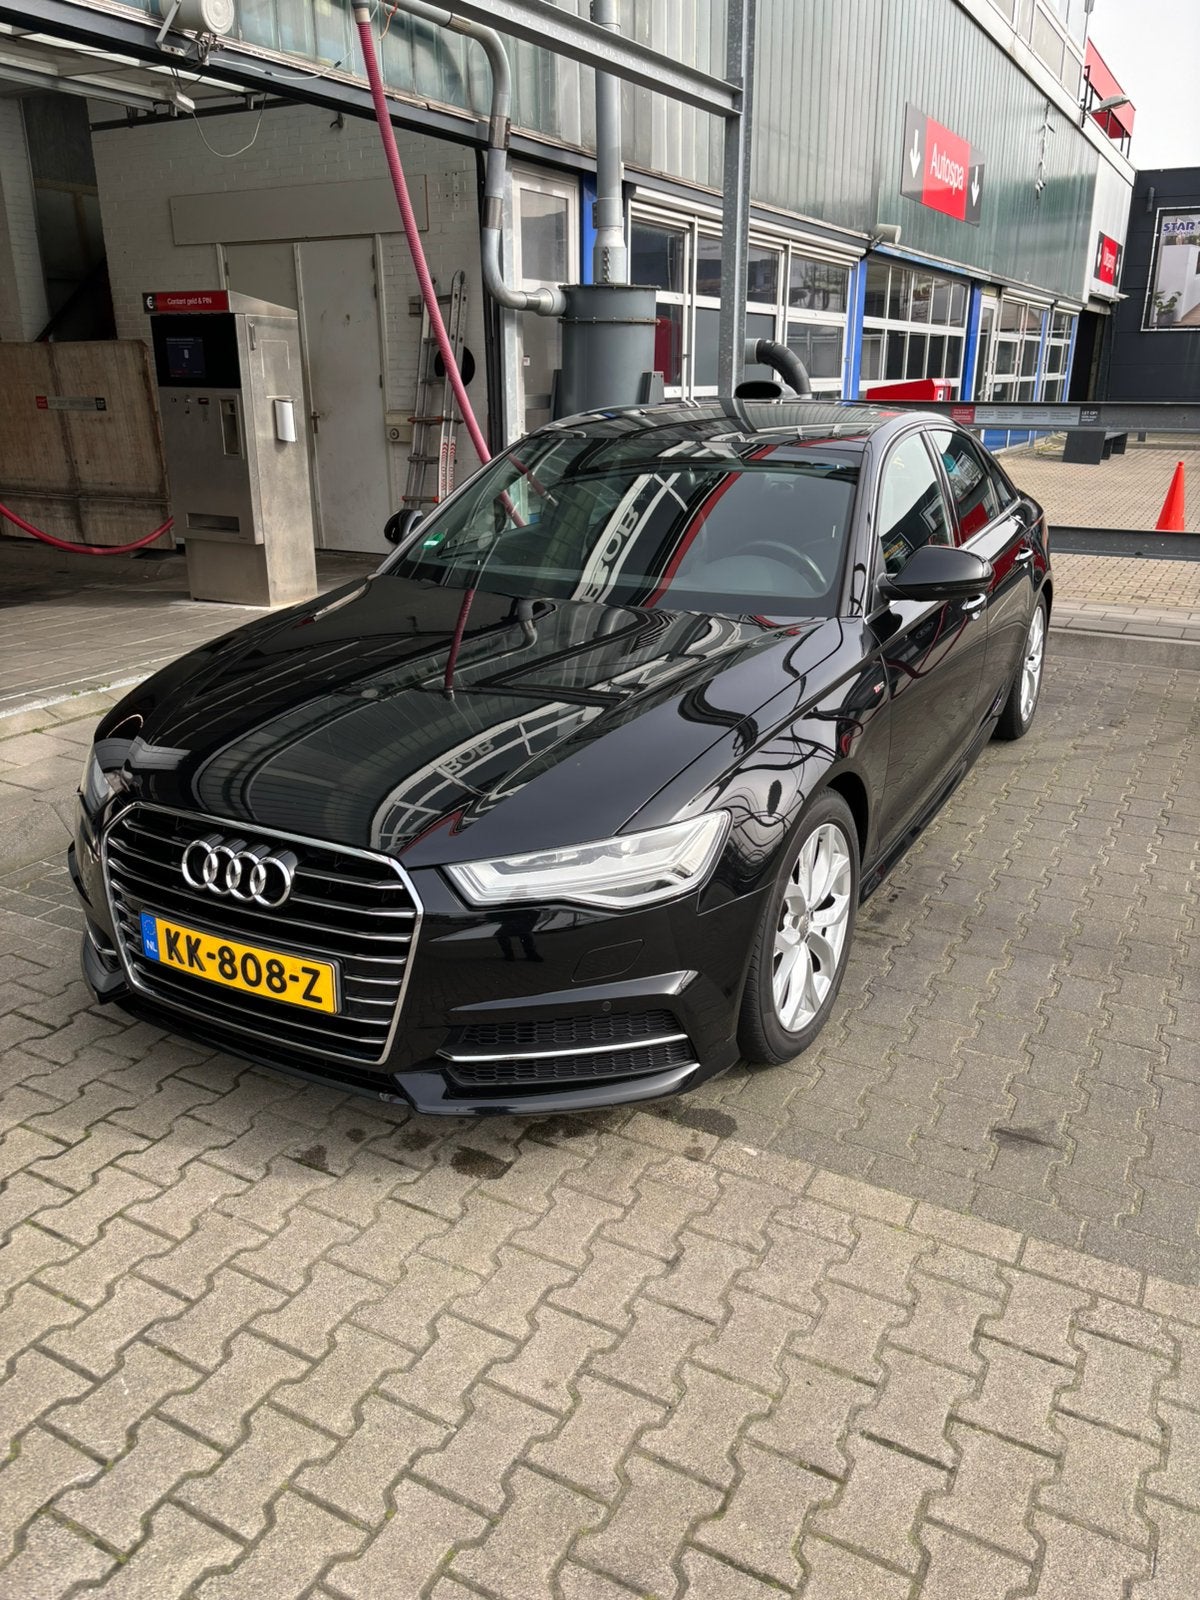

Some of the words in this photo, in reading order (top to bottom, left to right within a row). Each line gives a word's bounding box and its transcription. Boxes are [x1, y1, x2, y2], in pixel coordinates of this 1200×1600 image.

[929, 142, 965, 195] Autospa
[1163, 221, 1196, 231] STAR
[167, 297, 186, 305] Contant
[187, 297, 198, 306] geld
[202, 296, 212, 304] PIN
[146, 940, 158, 953] NL
[165, 927, 323, 1004] KK-808-Z
